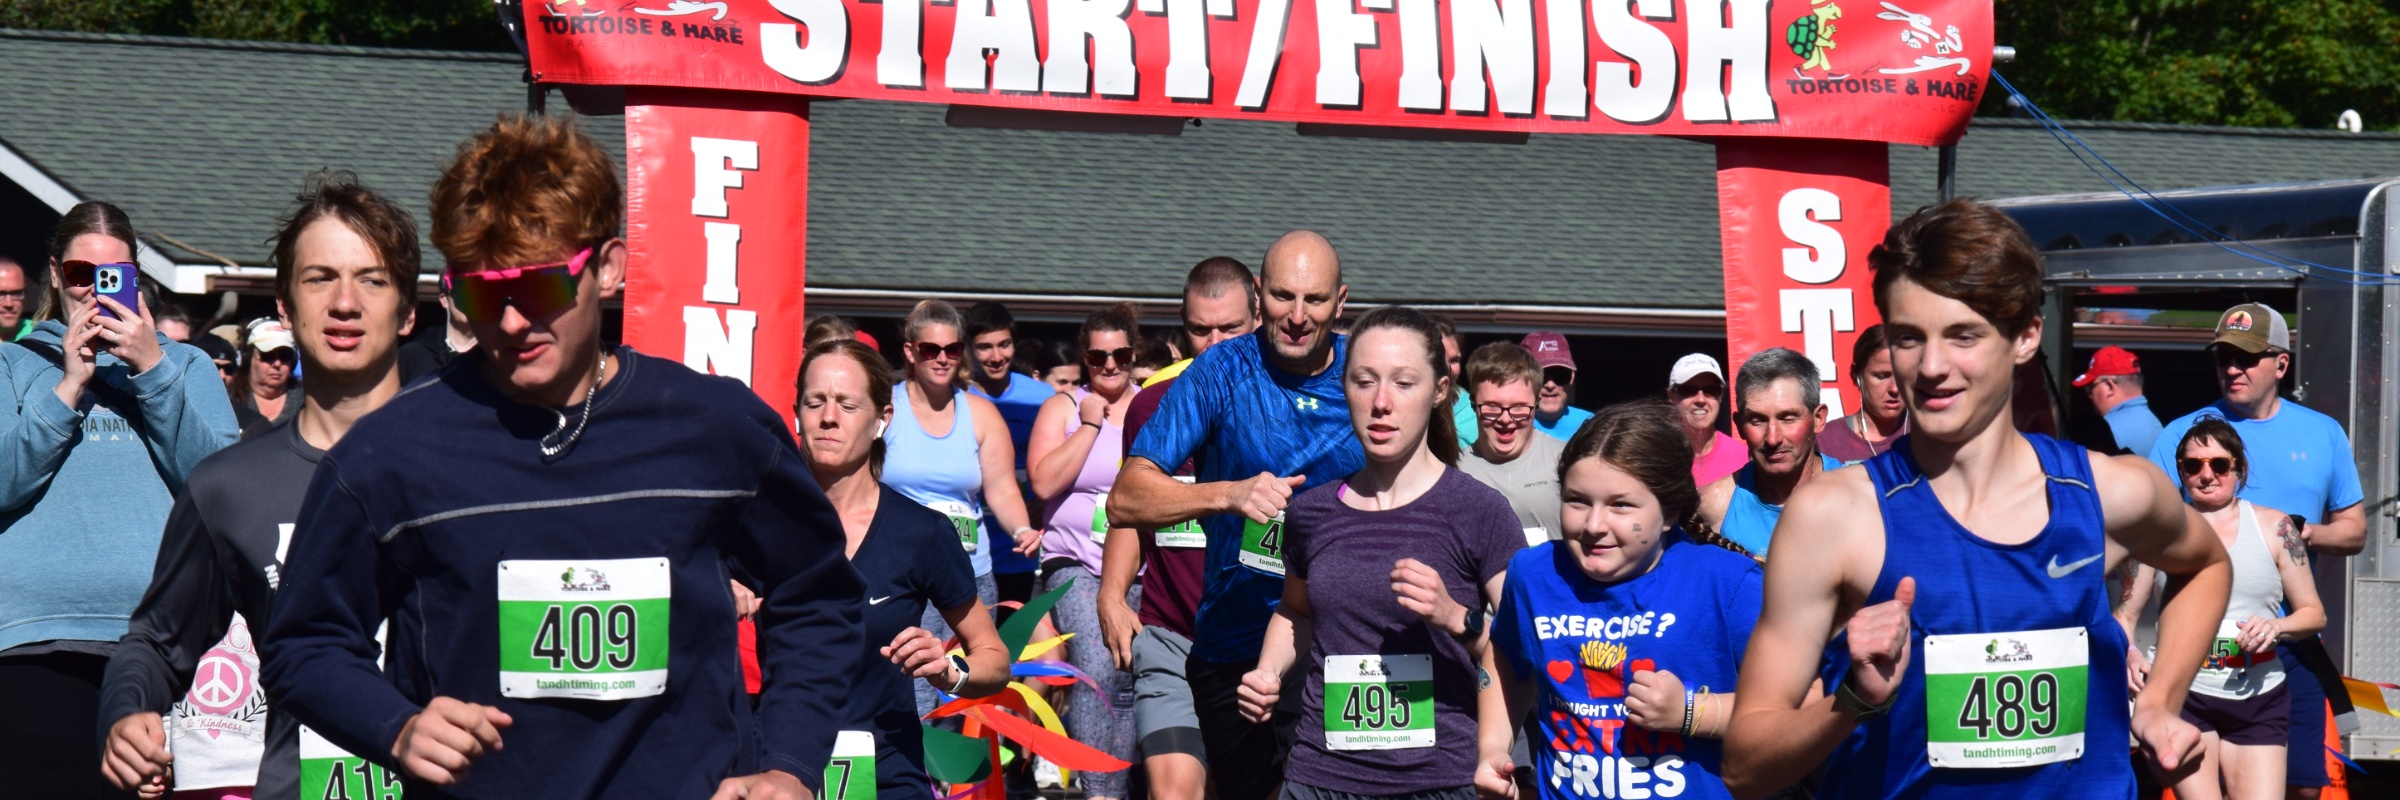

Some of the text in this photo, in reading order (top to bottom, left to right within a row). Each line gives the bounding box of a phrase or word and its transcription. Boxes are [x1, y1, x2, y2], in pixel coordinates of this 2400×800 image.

[538, 15, 744, 45] TORTOISE & HARE
[566, 39, 608, 48] RACE
[692, 43, 719, 52] LLC
[1786, 78, 1978, 101] TORTOISE & HARE
[1778, 187, 1854, 421] ST
[531, 603, 638, 671] 409
[536, 679, 635, 692] tandhtiming.com
[1341, 684, 1411, 730] 495
[1555, 695, 1609, 717] THOUGHT
[1958, 672, 2059, 739] 489
[187, 718, 242, 731] & Kindness
[1345, 734, 1411, 744] tandhtiming.com
[1963, 745, 2057, 758] tandhtiming.com
[1551, 751, 1686, 799] FRIES
